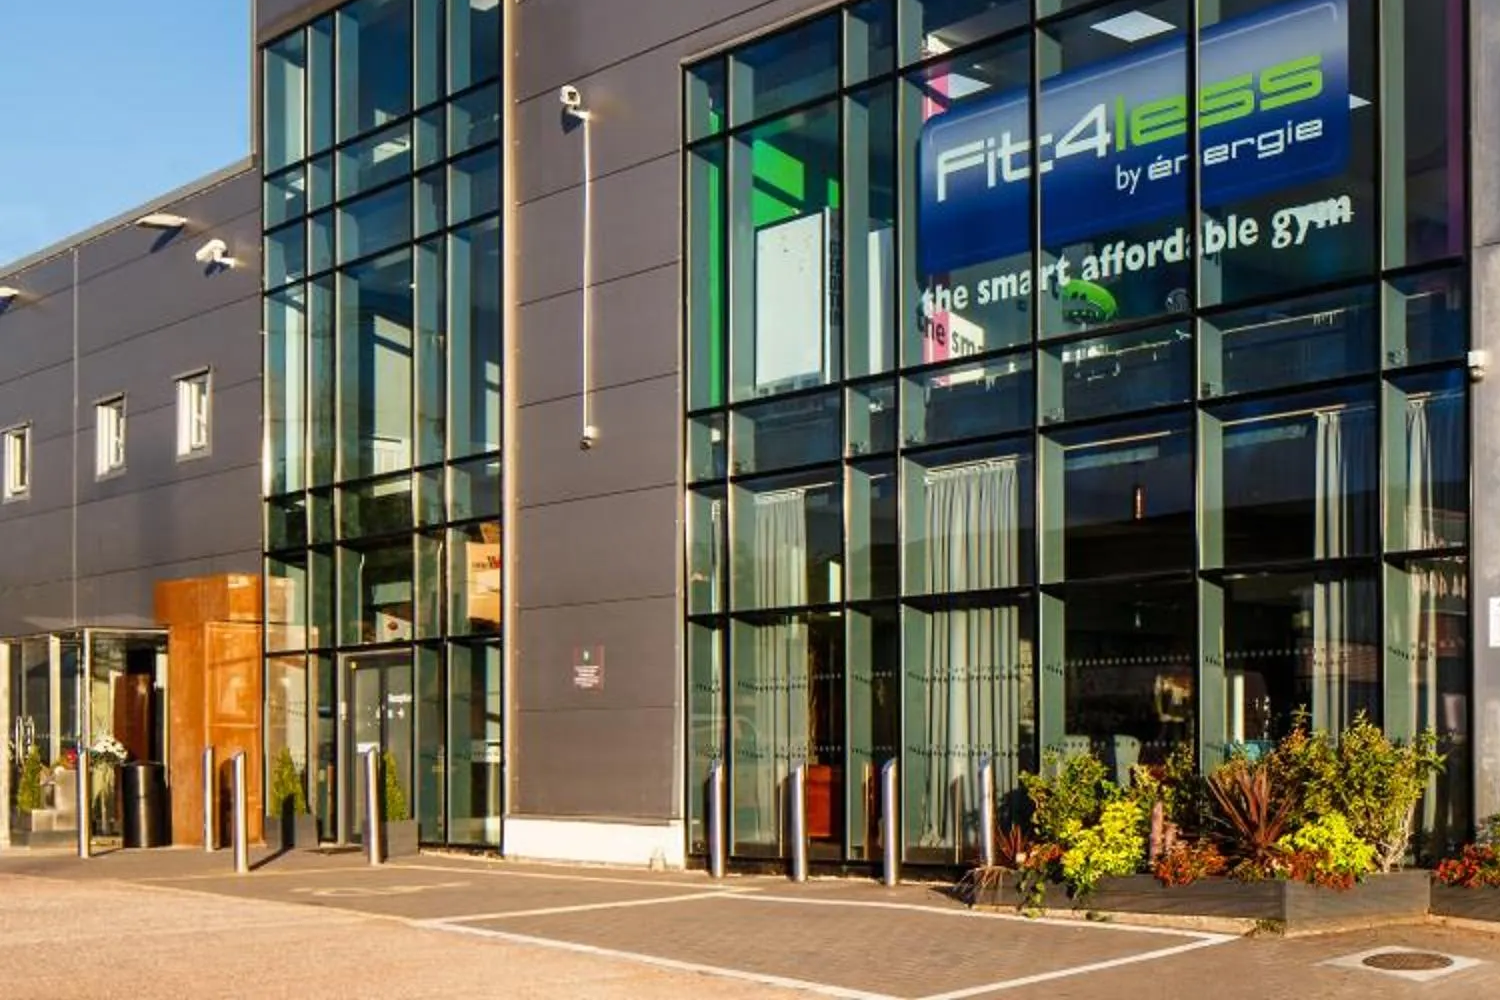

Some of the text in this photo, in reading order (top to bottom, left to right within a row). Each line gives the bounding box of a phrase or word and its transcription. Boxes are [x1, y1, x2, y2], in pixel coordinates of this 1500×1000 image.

[1116, 164, 1142, 195] by
[922, 284, 969, 318] the
[977, 254, 1071, 305] smart
